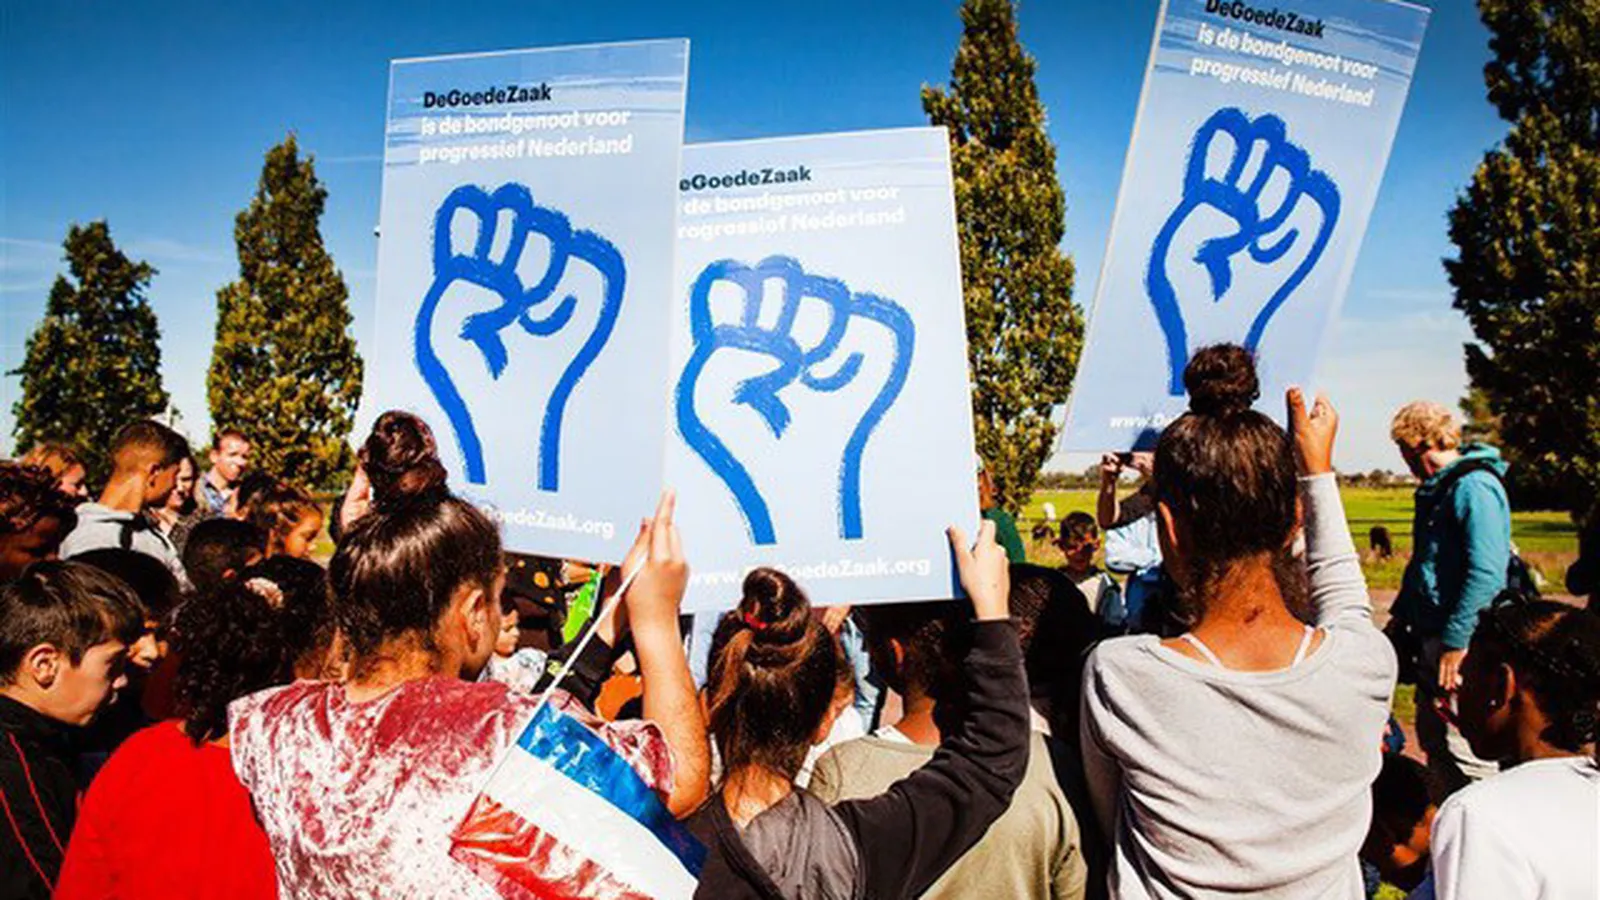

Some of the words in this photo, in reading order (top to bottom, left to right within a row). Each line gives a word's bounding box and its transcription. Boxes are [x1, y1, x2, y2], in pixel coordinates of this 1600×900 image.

[1204, 0, 1326, 38] DeGoedeZaak
[1197, 22, 1214, 45] is
[1216, 28, 1239, 50] de
[1240, 32, 1342, 72] bondgenoot
[1343, 60, 1379, 80] voor
[423, 83, 552, 109] DeGoedeZaak
[1190, 57, 1292, 91] progressief
[1291, 73, 1374, 106] Nederland
[421, 117, 436, 135] is
[439, 115, 462, 134] de
[464, 111, 580, 134] bondgenoot
[582, 111, 632, 126] voor
[419, 139, 524, 164] progressief
[527, 134, 633, 157] Nederland
[679, 165, 812, 191] eGoedeZaak
[684, 197, 711, 215] de
[715, 188, 845, 212] bondgenoot
[850, 186, 901, 201] voor
[678, 214, 787, 240] rogressief
[792, 205, 906, 231] Nederland
[480, 504, 615, 540] GoedeZaak.org
[689, 557, 931, 586] www.oedeZaak.org
